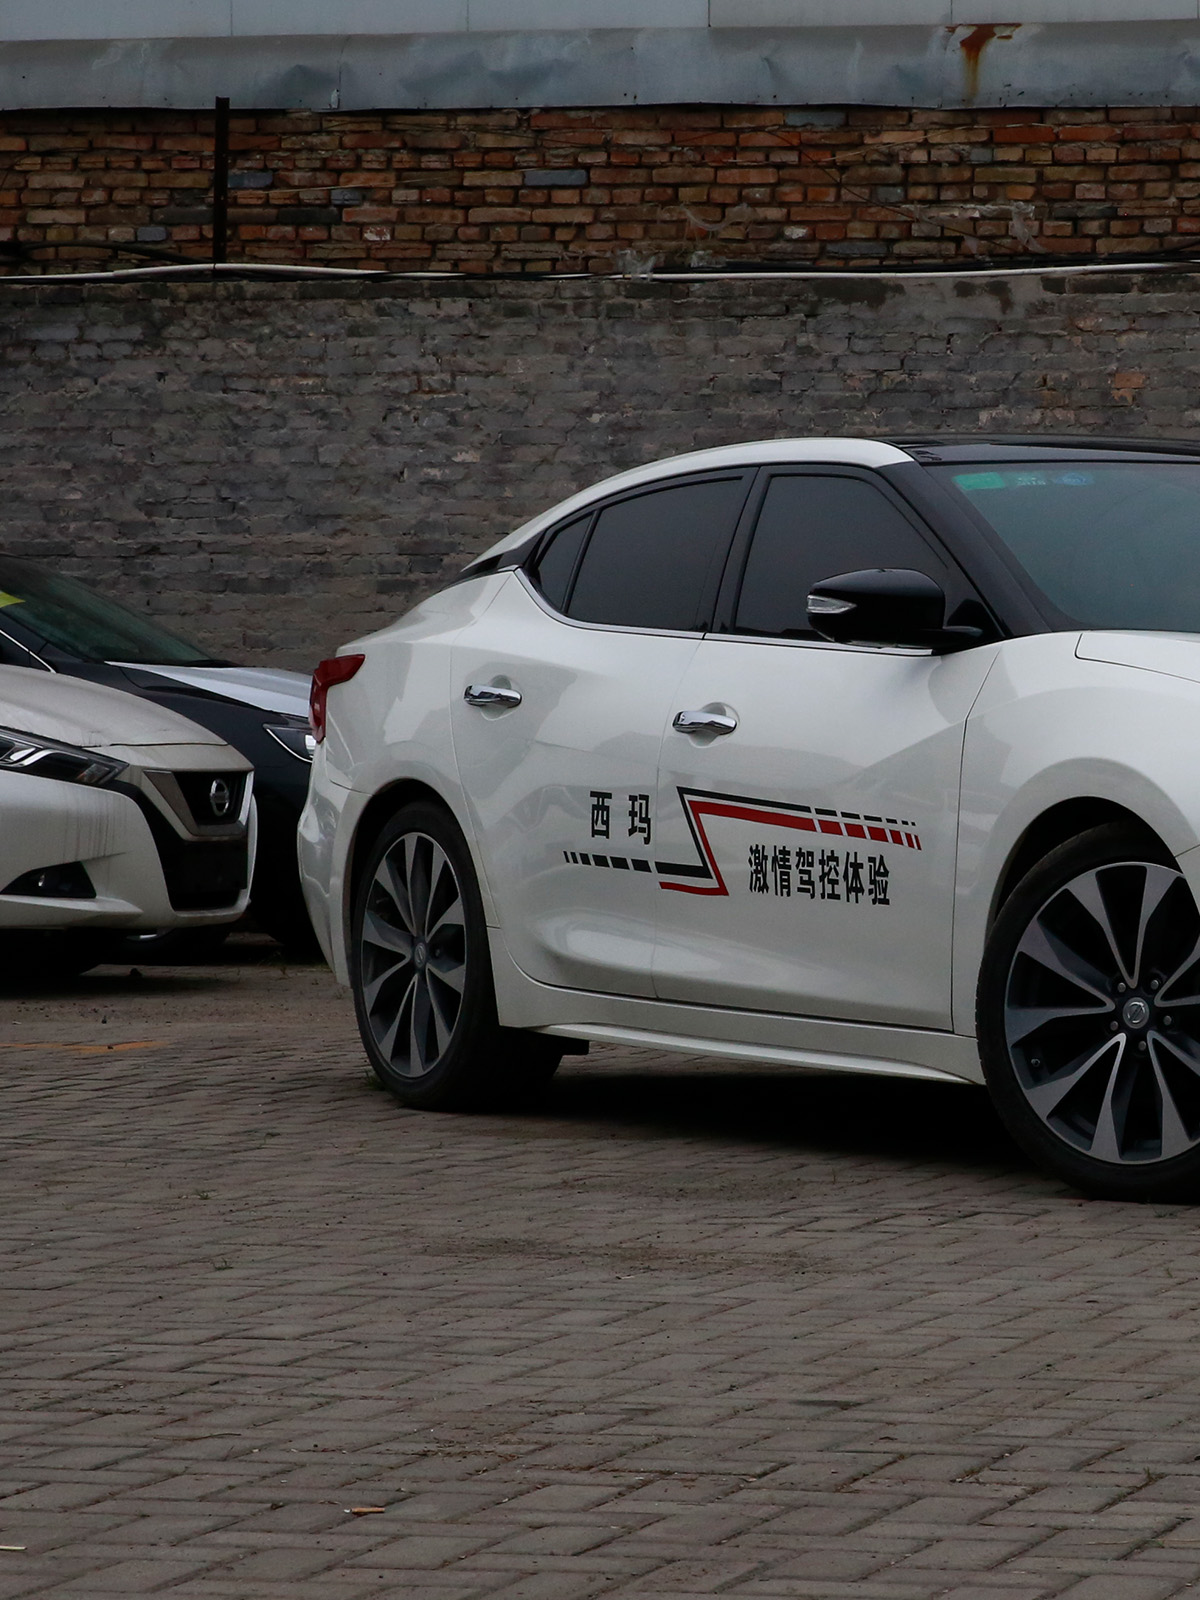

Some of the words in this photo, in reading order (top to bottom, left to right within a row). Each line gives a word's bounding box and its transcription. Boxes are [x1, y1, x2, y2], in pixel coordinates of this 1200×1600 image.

[589, 790, 652, 845] 西玛
[748, 843, 891, 906] 激情驾控体验
